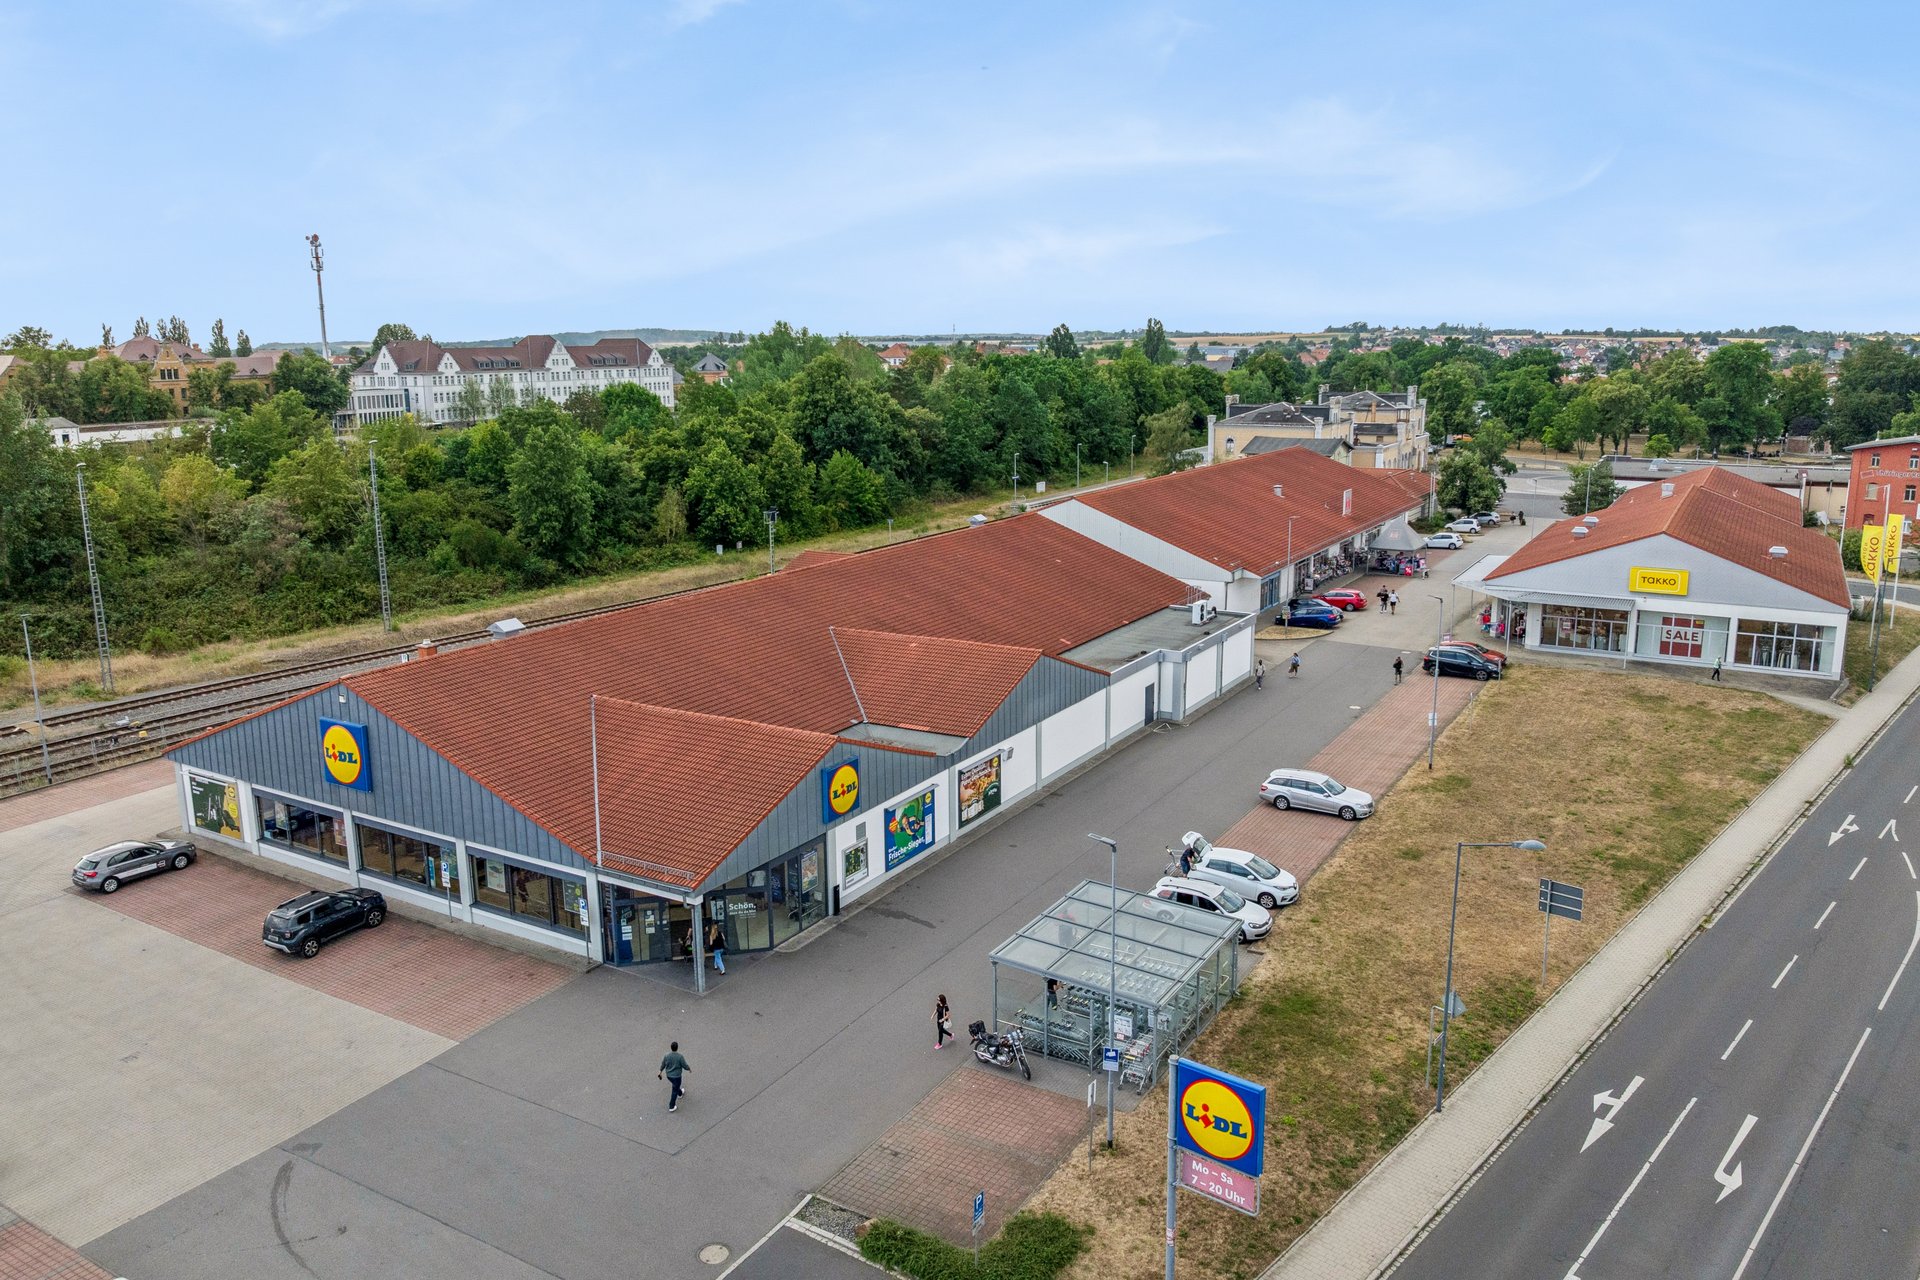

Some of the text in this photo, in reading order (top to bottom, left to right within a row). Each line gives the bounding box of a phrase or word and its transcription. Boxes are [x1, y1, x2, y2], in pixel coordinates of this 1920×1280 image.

[1665, 629, 1699, 642] SALE
[729, 902, 757, 911] Schön,
[1192, 1160, 1209, 1175] Mo
[1221, 1173, 1234, 1186] Sa
[1191, 1174, 1198, 1184] 7
[1209, 1183, 1223, 1196] 20
[1225, 1190, 1246, 1205] Uhr
[976, 1194, 982, 1209] P
